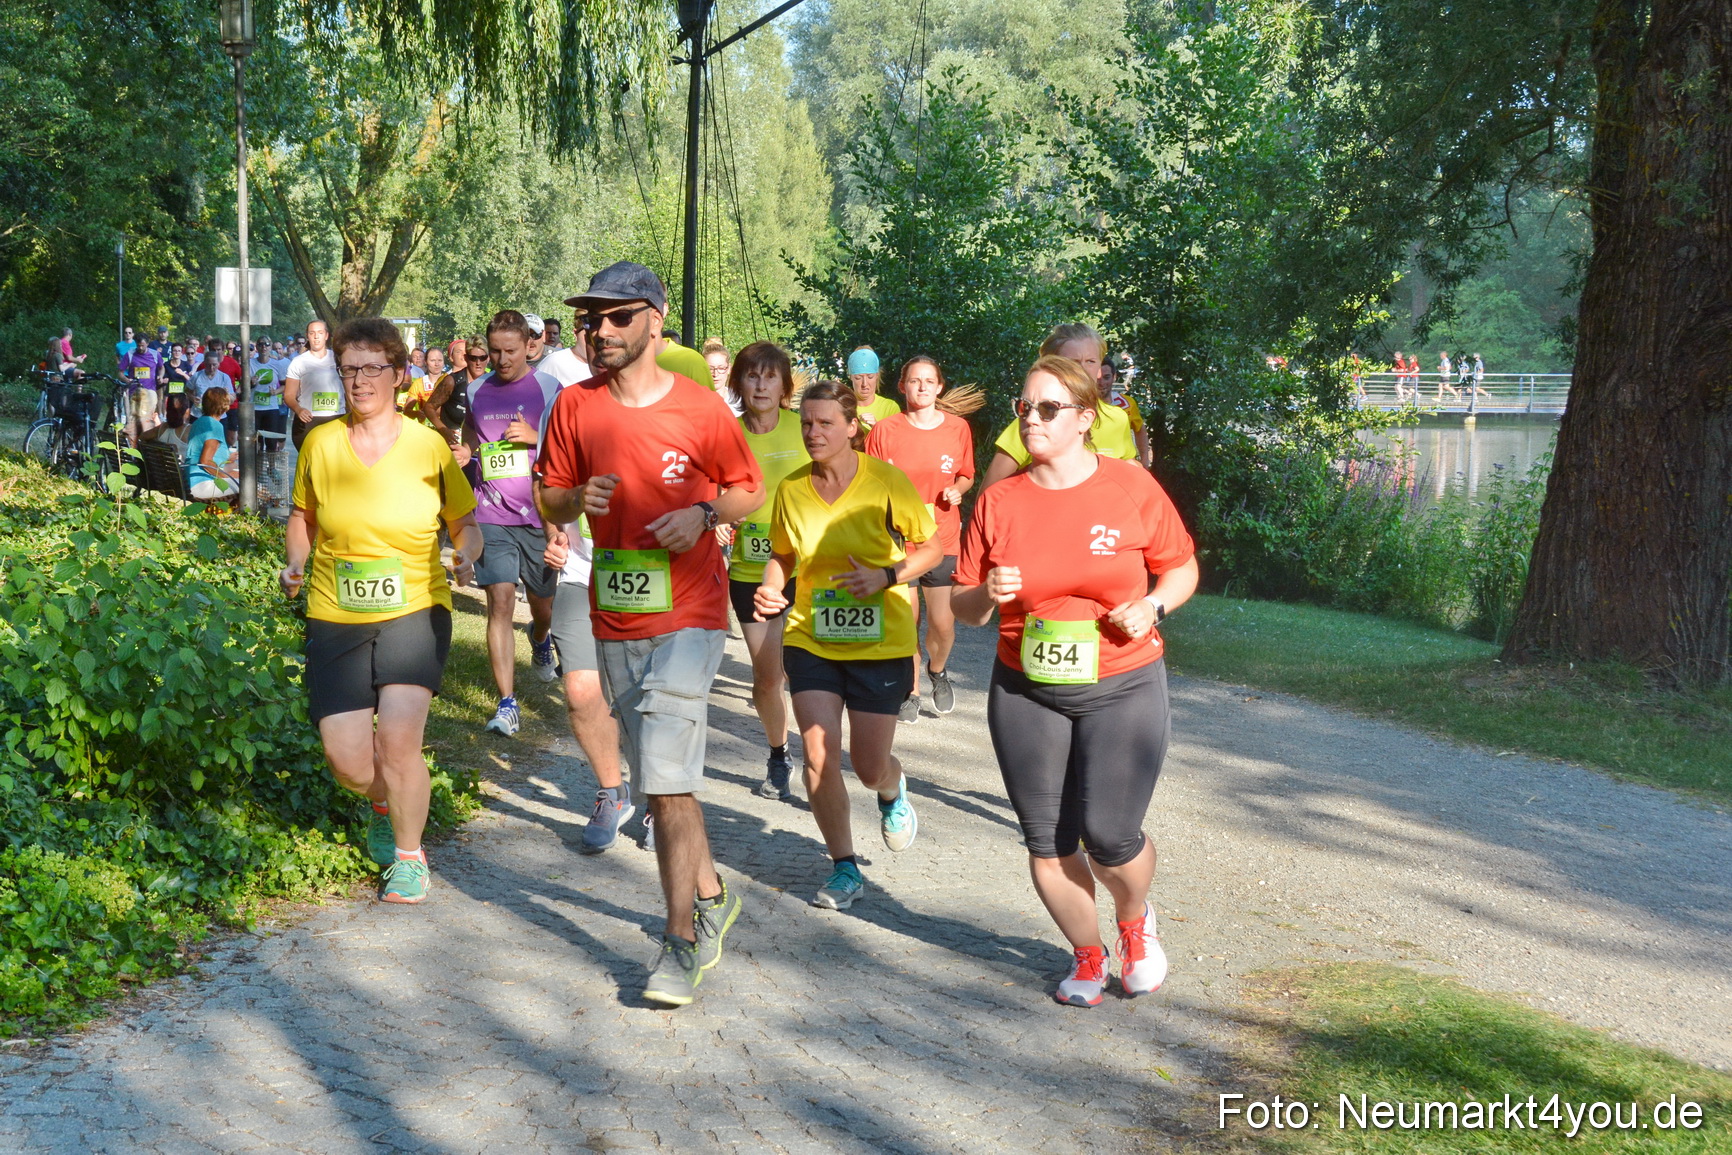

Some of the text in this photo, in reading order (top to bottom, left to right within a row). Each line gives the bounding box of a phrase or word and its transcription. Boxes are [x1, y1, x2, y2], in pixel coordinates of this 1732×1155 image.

[490, 453, 514, 469] 691
[661, 450, 689, 478] 25
[940, 454, 954, 470] 25
[1090, 524, 1120, 550] 25
[343, 578, 396, 598] 1676
[608, 572, 650, 594] 452
[820, 608, 874, 627] 1628
[1032, 642, 1079, 666] 454
